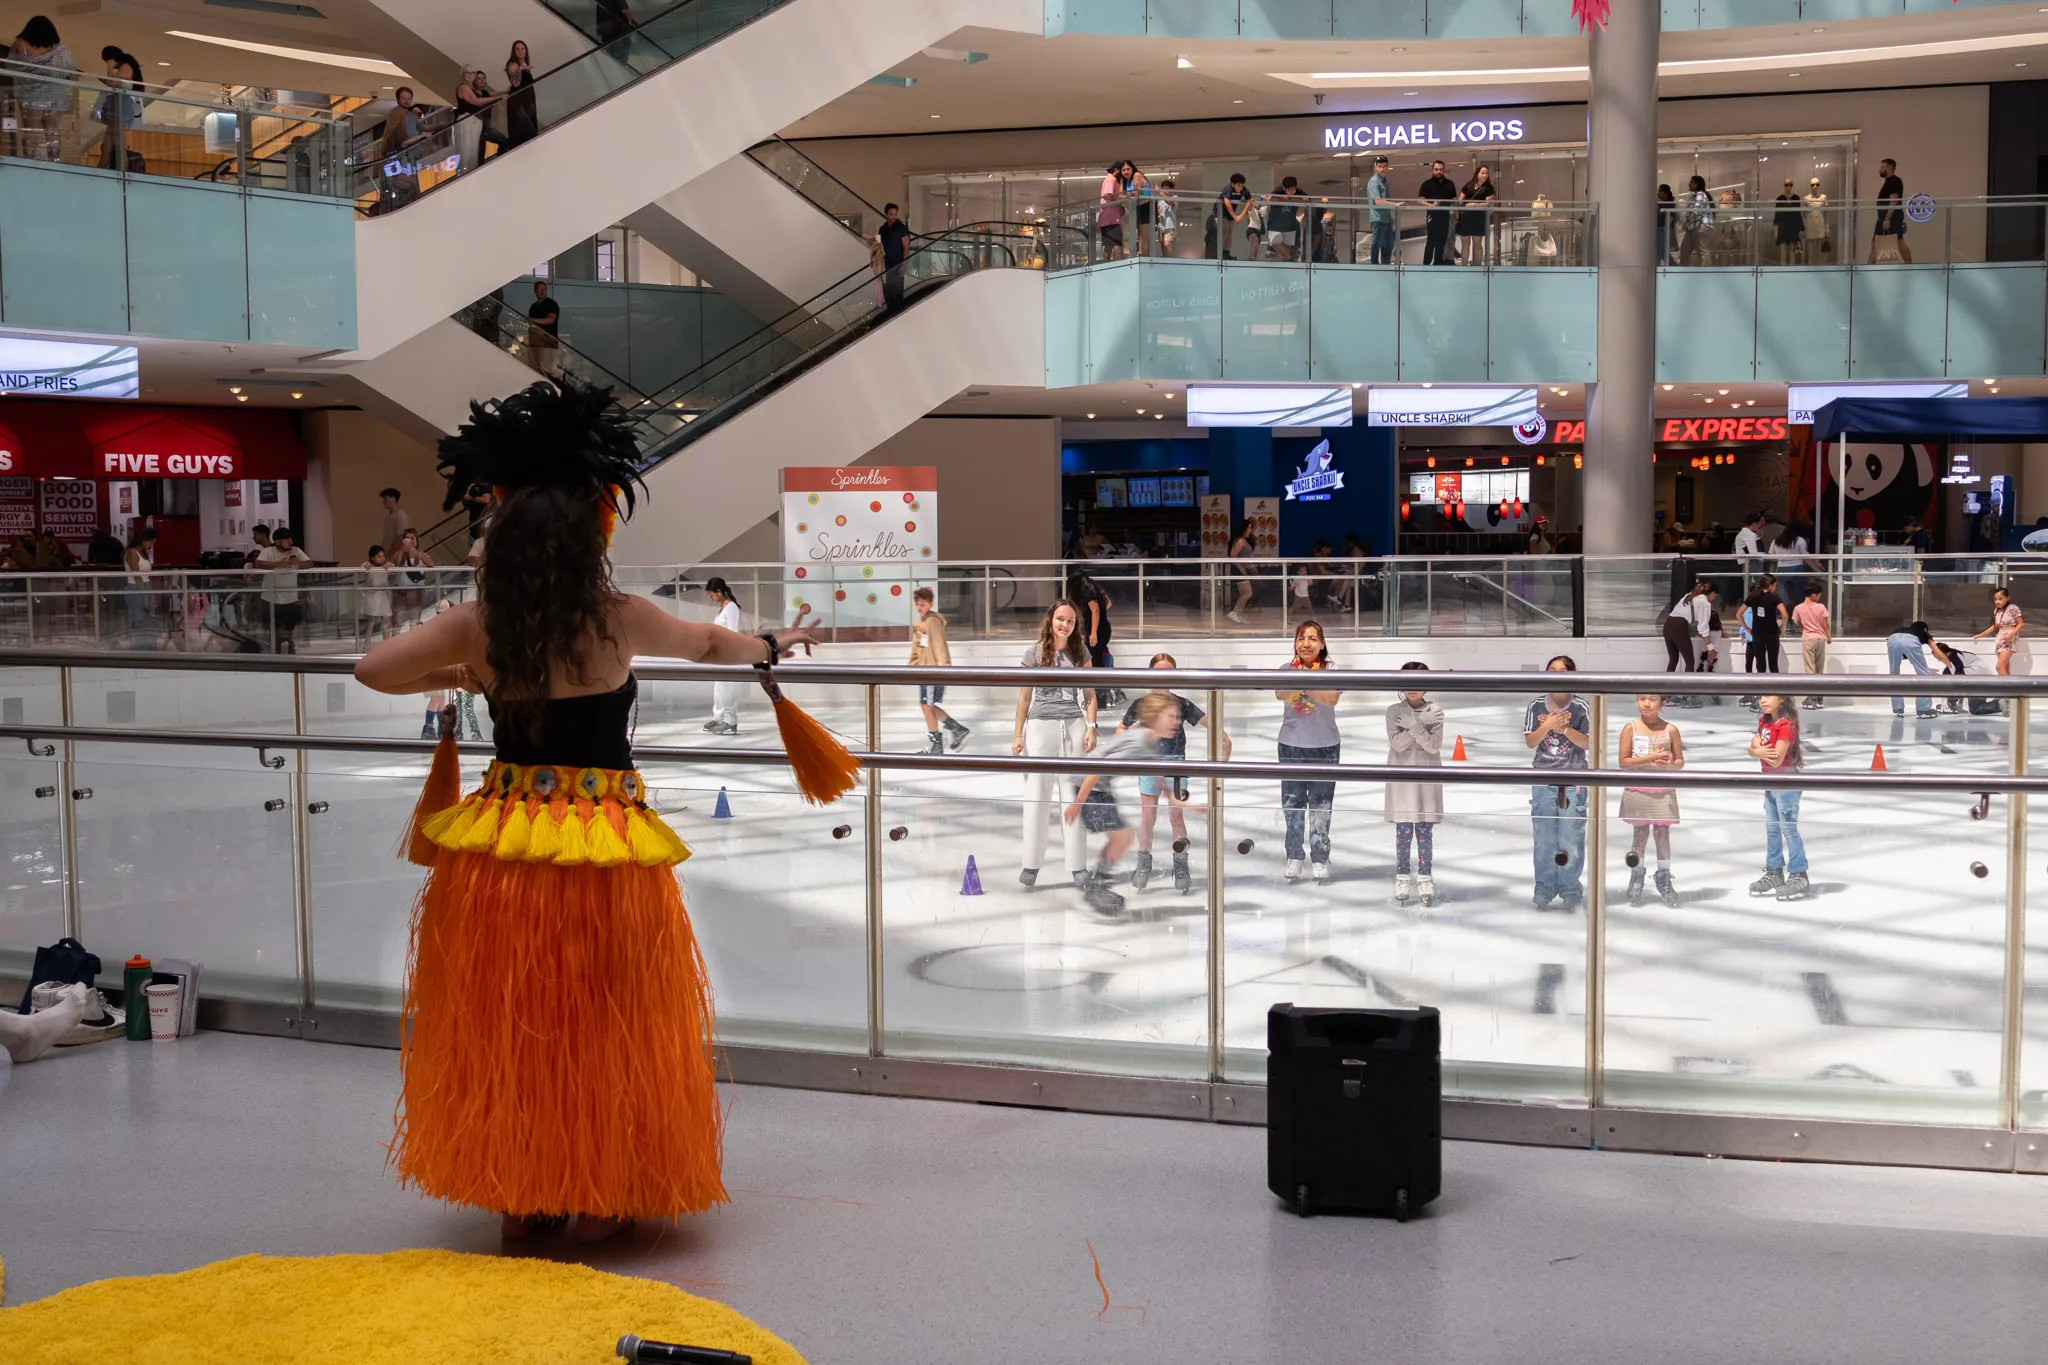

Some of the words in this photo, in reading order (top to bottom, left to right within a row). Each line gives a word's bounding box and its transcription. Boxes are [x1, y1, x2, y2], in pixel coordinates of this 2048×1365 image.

[1325, 124, 1441, 148] MICHAEL
[1451, 120, 1524, 142] KORS
[35, 375, 78, 391] FRIES
[1381, 413, 1421, 424] UNCLE
[1424, 413, 1471, 424] SHARKII
[1662, 417, 1788, 442] EXPRESS
[105, 453, 160, 473] FIVE
[167, 454, 233, 474] GUYS
[831, 468, 892, 490] Sprinkles
[1293, 477, 1311, 493] UNCLE
[43, 482, 94, 495] GOOD
[44, 497, 94, 509] FOOD
[24, 513, 32, 521] &
[44, 513, 94, 523] SERVED
[809, 531, 914, 563] Sprinkles
